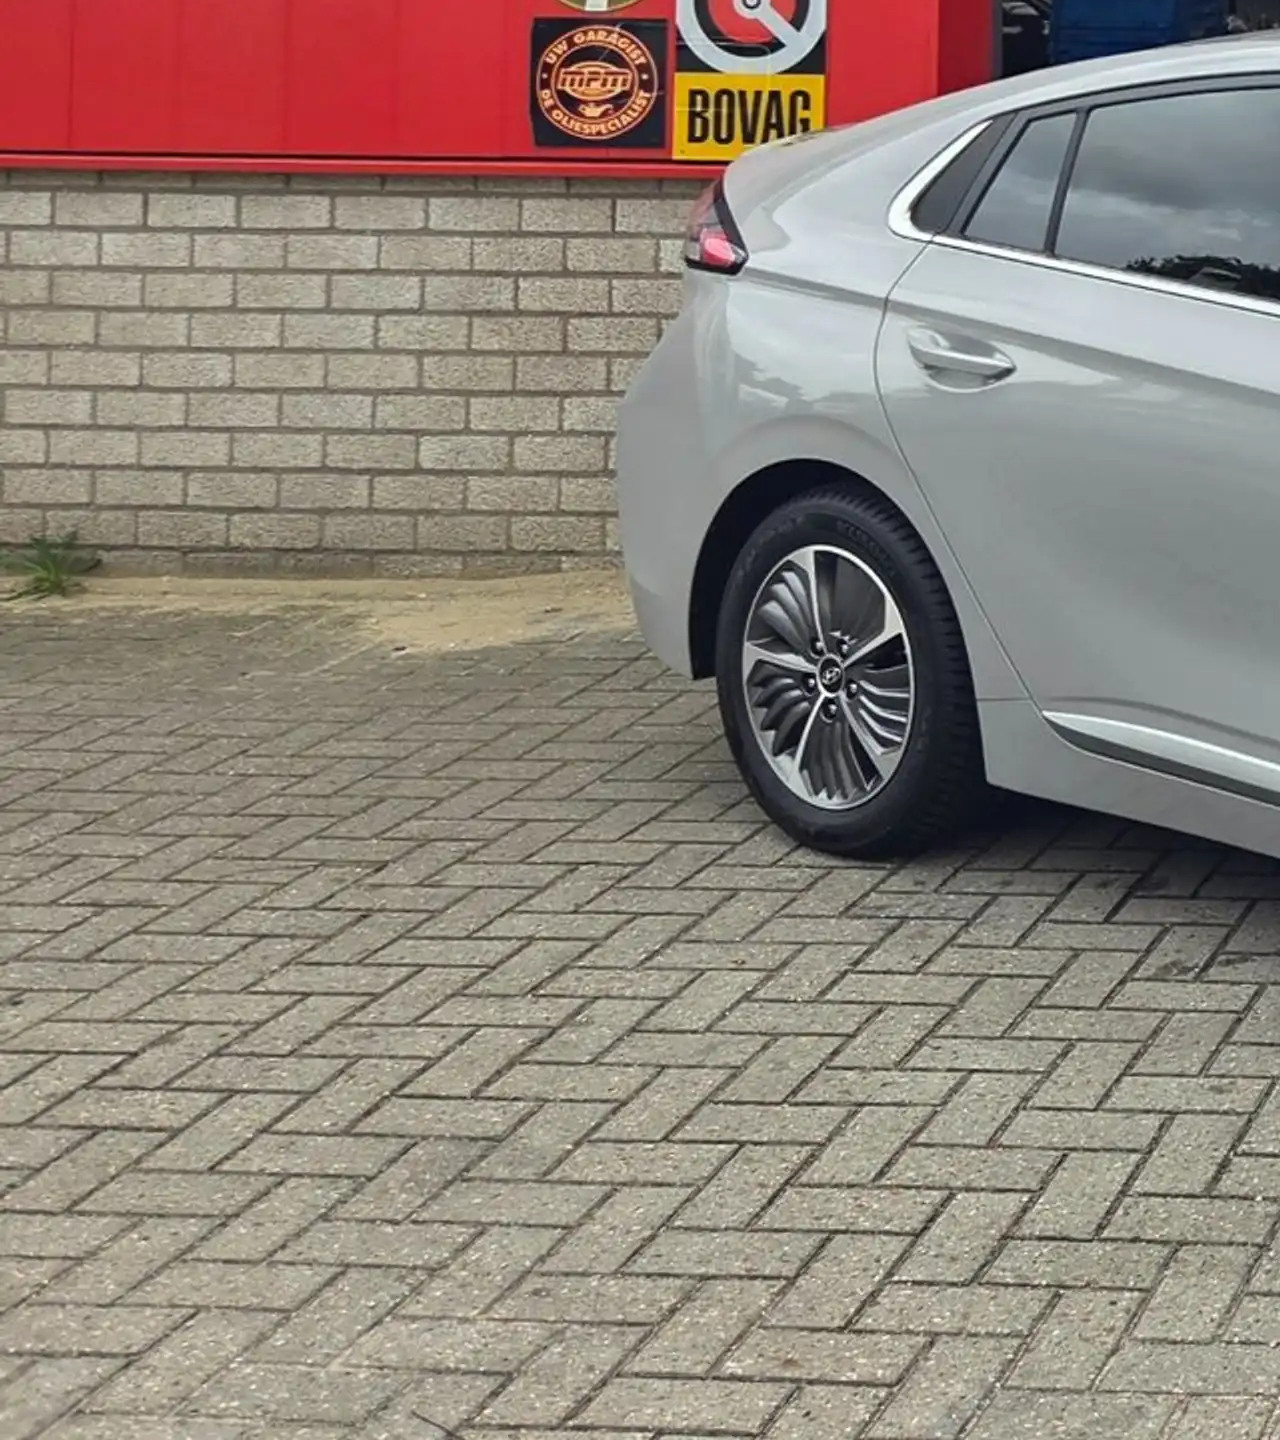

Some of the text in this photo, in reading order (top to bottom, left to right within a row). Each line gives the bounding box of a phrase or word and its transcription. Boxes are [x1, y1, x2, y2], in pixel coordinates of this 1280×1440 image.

[544, 30, 648, 65] UW GARAGIST
[541, 90, 652, 135] DE OLIESPECIALIST
[687, 88, 812, 146] BOVAG
